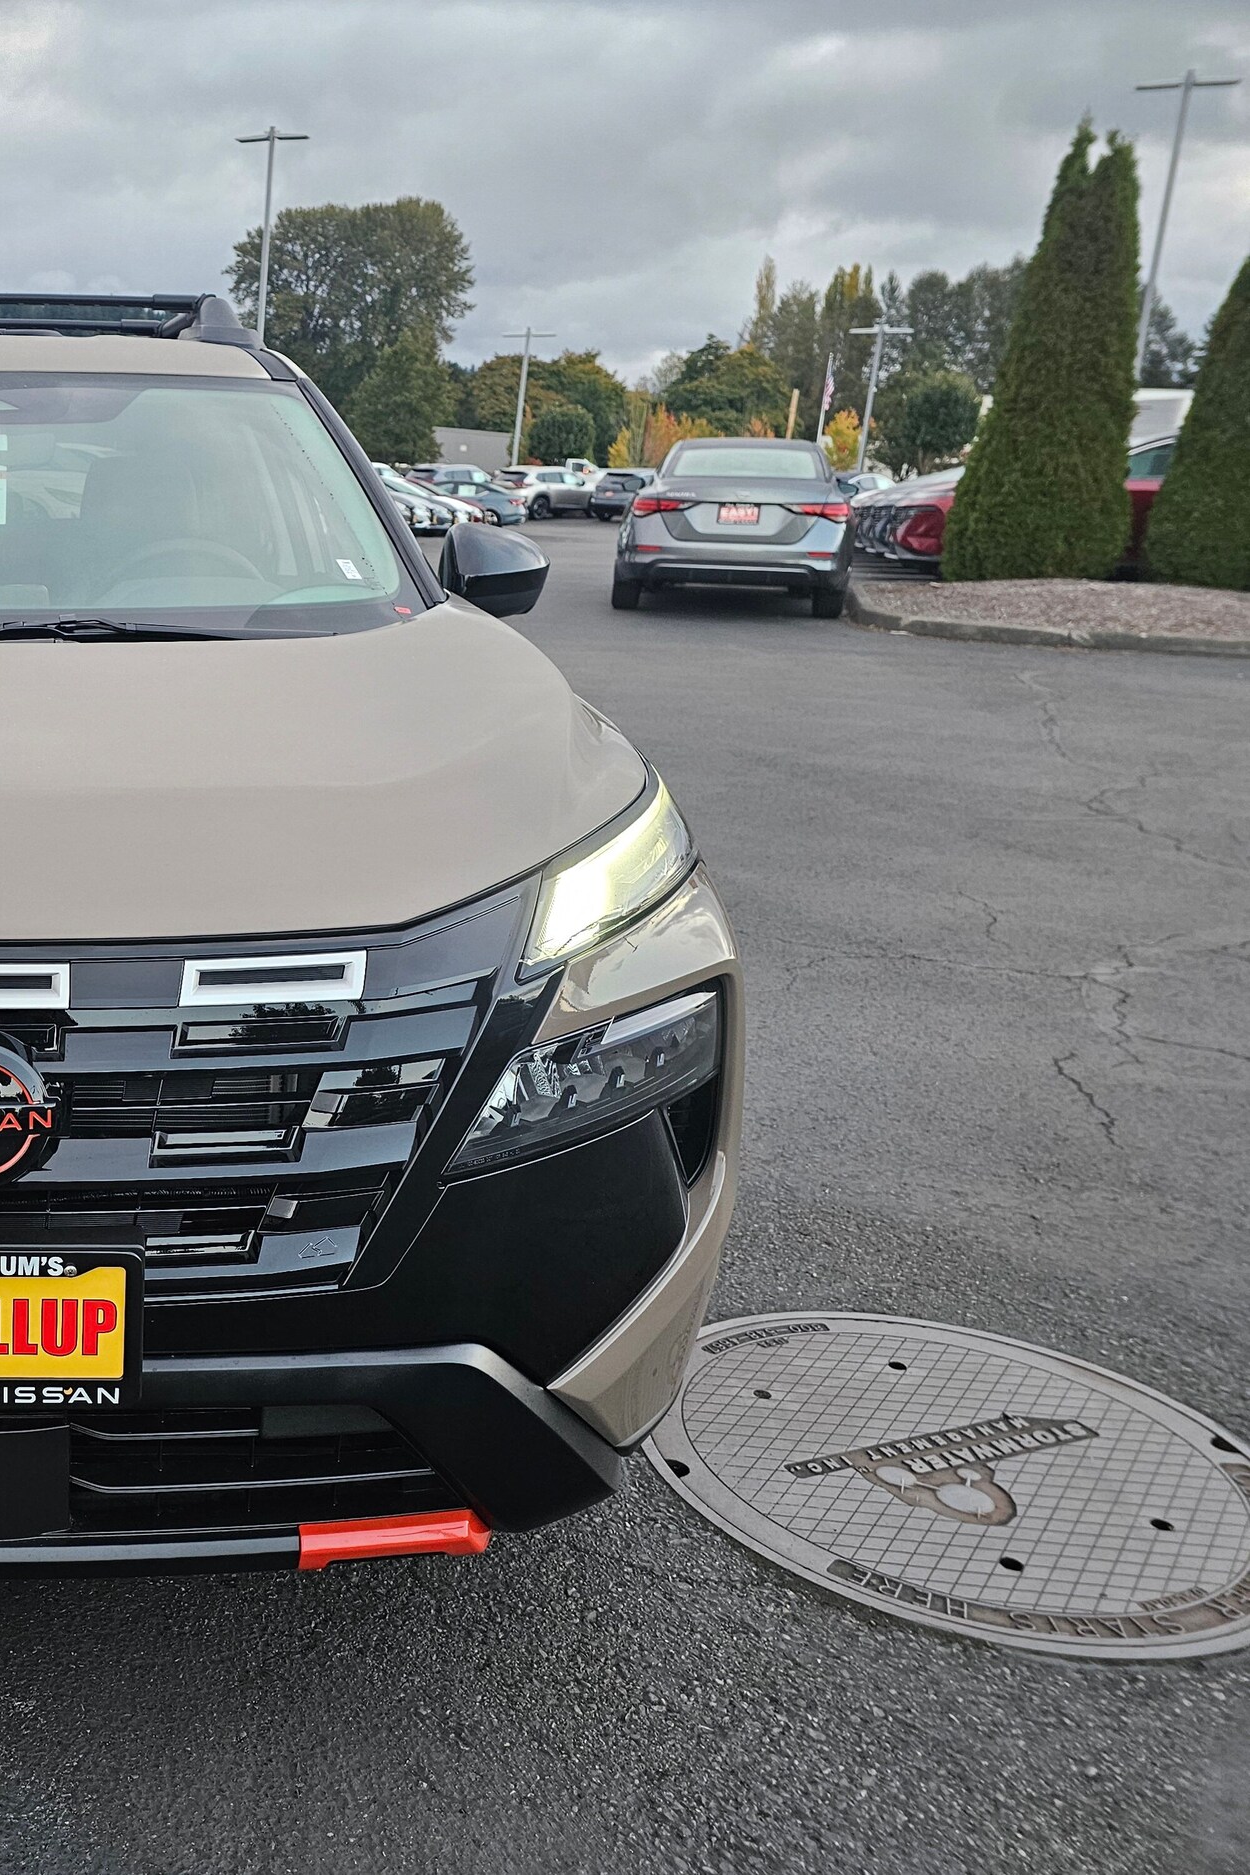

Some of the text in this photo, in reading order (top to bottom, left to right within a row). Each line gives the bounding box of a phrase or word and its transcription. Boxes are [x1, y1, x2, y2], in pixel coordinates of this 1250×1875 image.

[866, 1414, 1030, 1461] MANAGEMENT
[903, 1421, 1089, 1475] STORMWATER
[847, 1571, 1185, 1639] STARTS HERE
